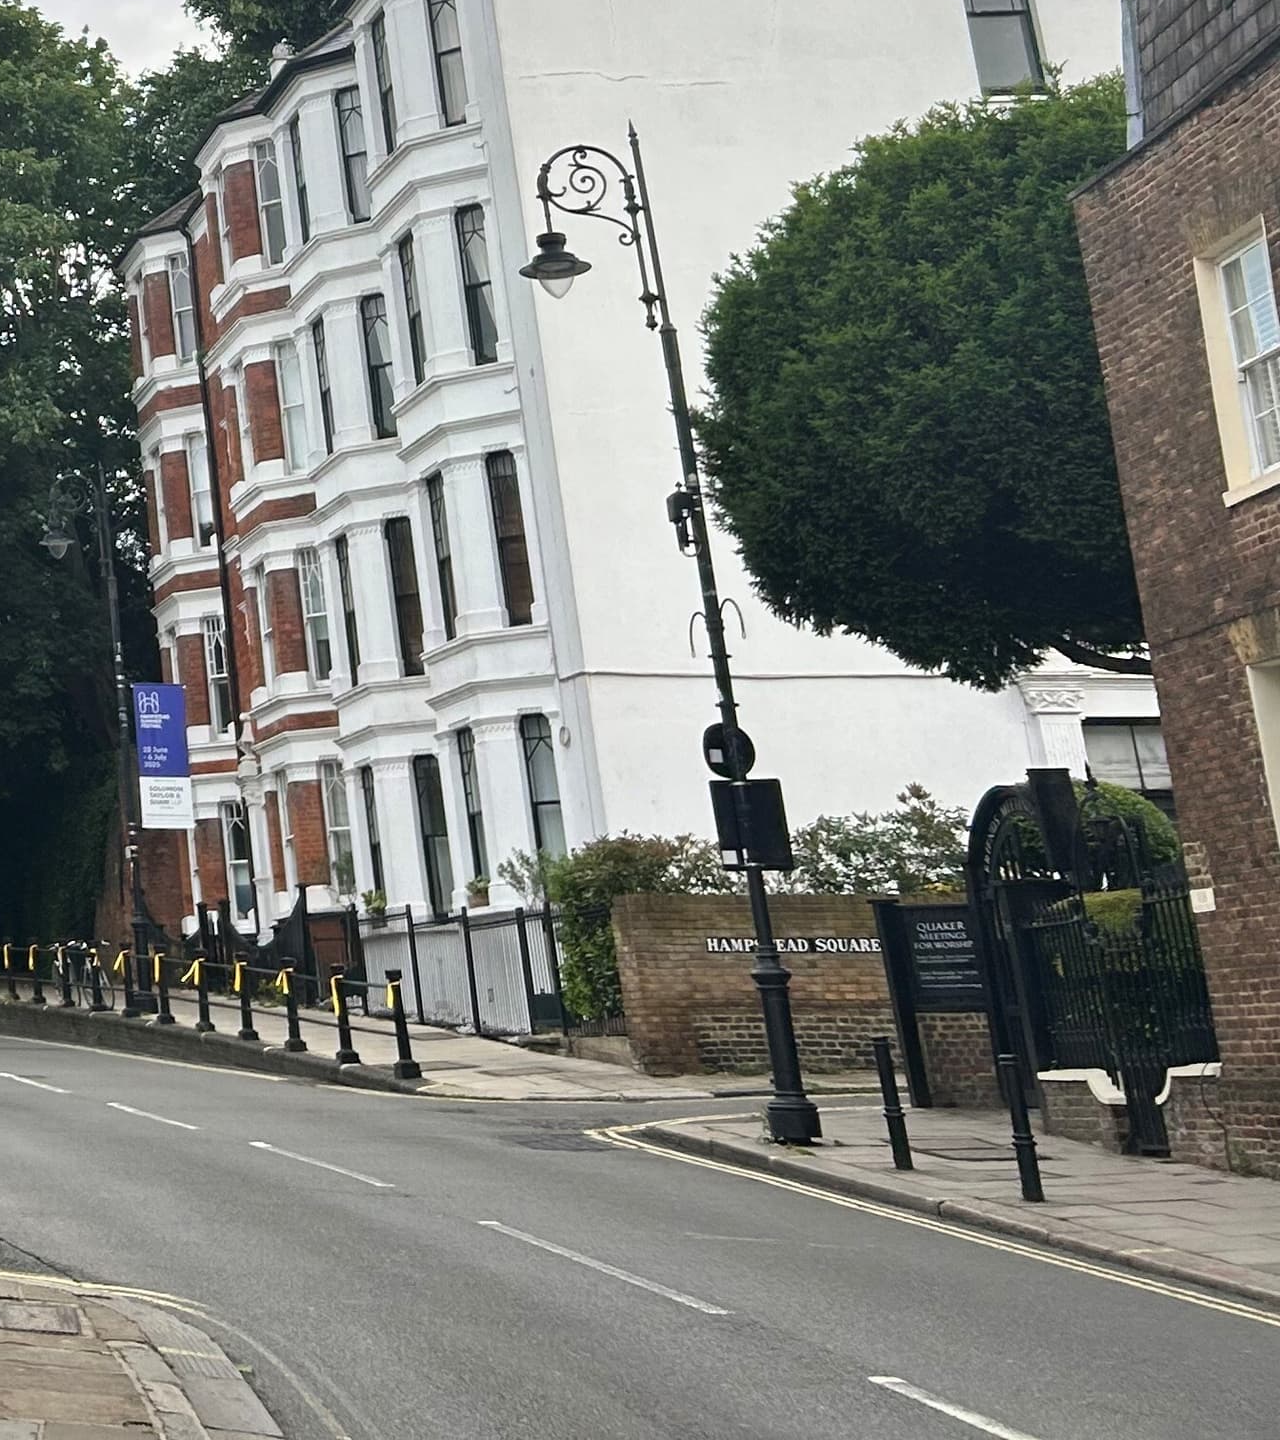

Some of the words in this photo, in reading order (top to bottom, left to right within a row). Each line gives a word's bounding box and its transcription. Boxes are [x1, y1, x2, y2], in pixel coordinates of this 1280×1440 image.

[916, 921, 965, 933] QUAKER
[706, 938, 809, 952] HAMPEAD
[815, 938, 881, 953] SQUARE
[914, 941, 934, 950] FOR
[935, 940, 973, 949] WORSHIP
